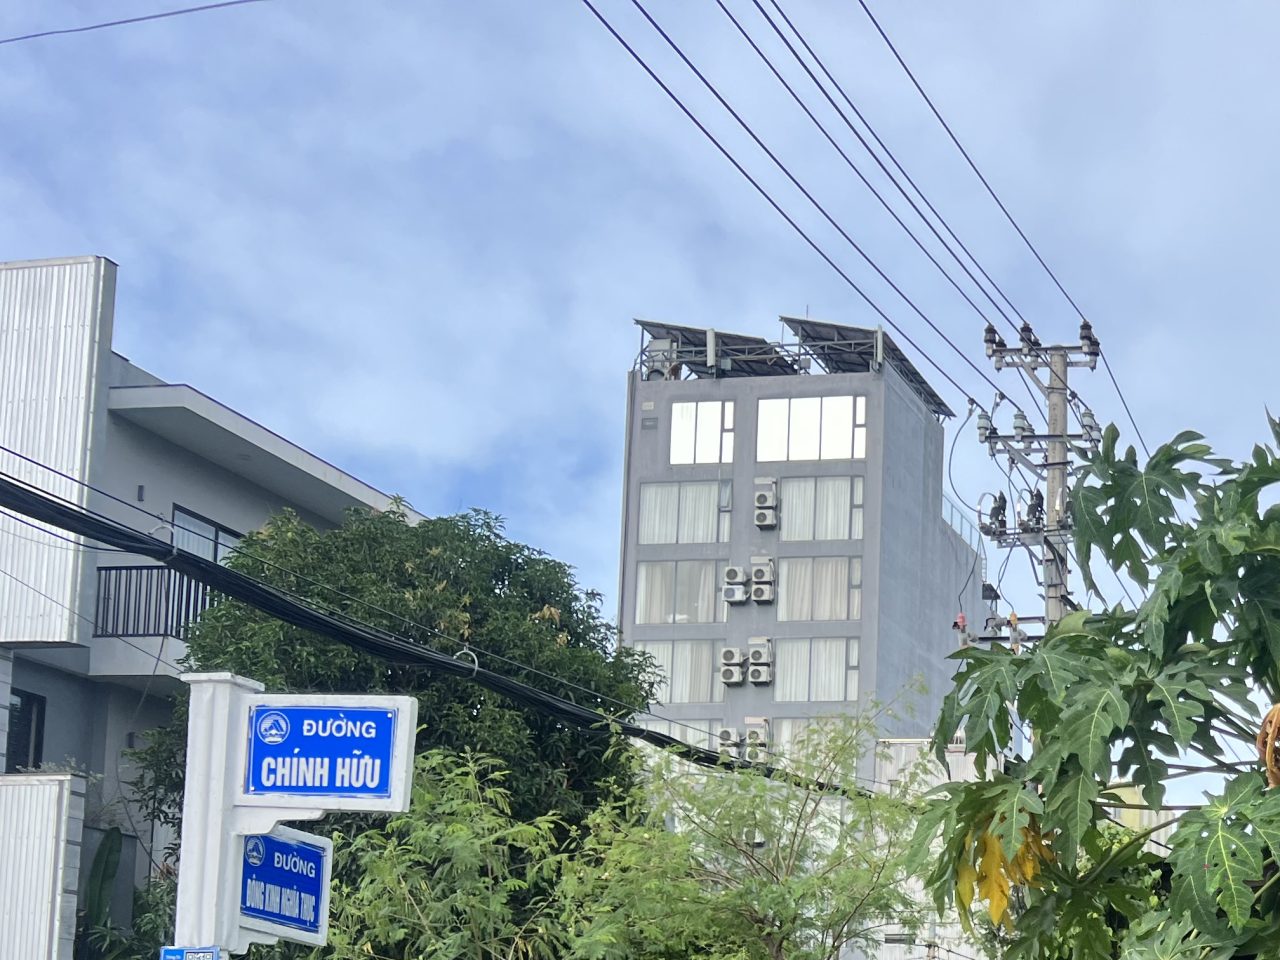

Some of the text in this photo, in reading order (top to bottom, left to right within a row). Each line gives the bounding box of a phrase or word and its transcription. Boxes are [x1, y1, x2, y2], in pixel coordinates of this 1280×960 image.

[302, 713, 377, 739] ĐƯỜNG
[260, 748, 381, 789] CHÍNH HỮU
[273, 851, 316, 878] ĐƯỜNG
